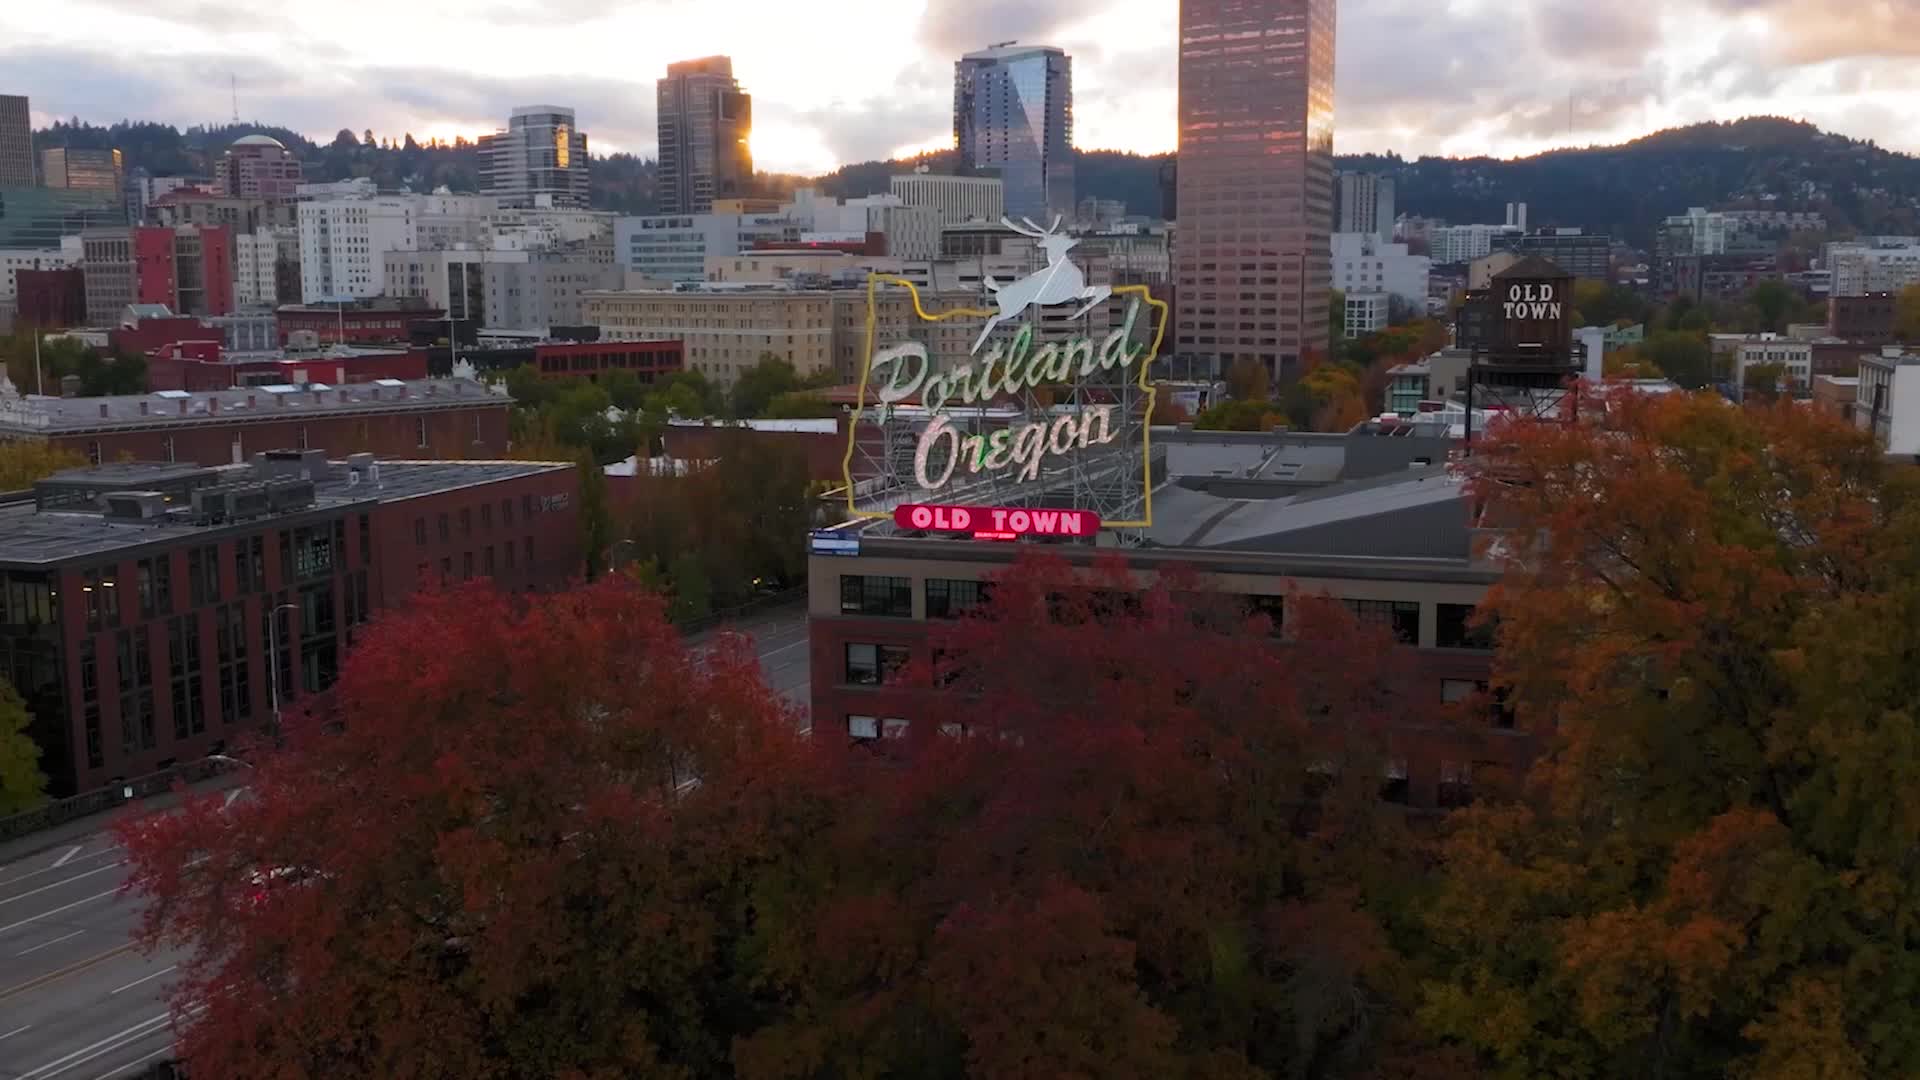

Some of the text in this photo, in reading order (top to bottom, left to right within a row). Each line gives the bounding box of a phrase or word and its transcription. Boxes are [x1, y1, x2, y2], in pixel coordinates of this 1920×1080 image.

[1509, 284, 1553, 302] OLD
[1503, 302, 1561, 319] TOWN
[870, 297, 1144, 425] Portland
[914, 405, 1120, 489] Oregon
[911, 506, 1081, 534] OLD TOWN
